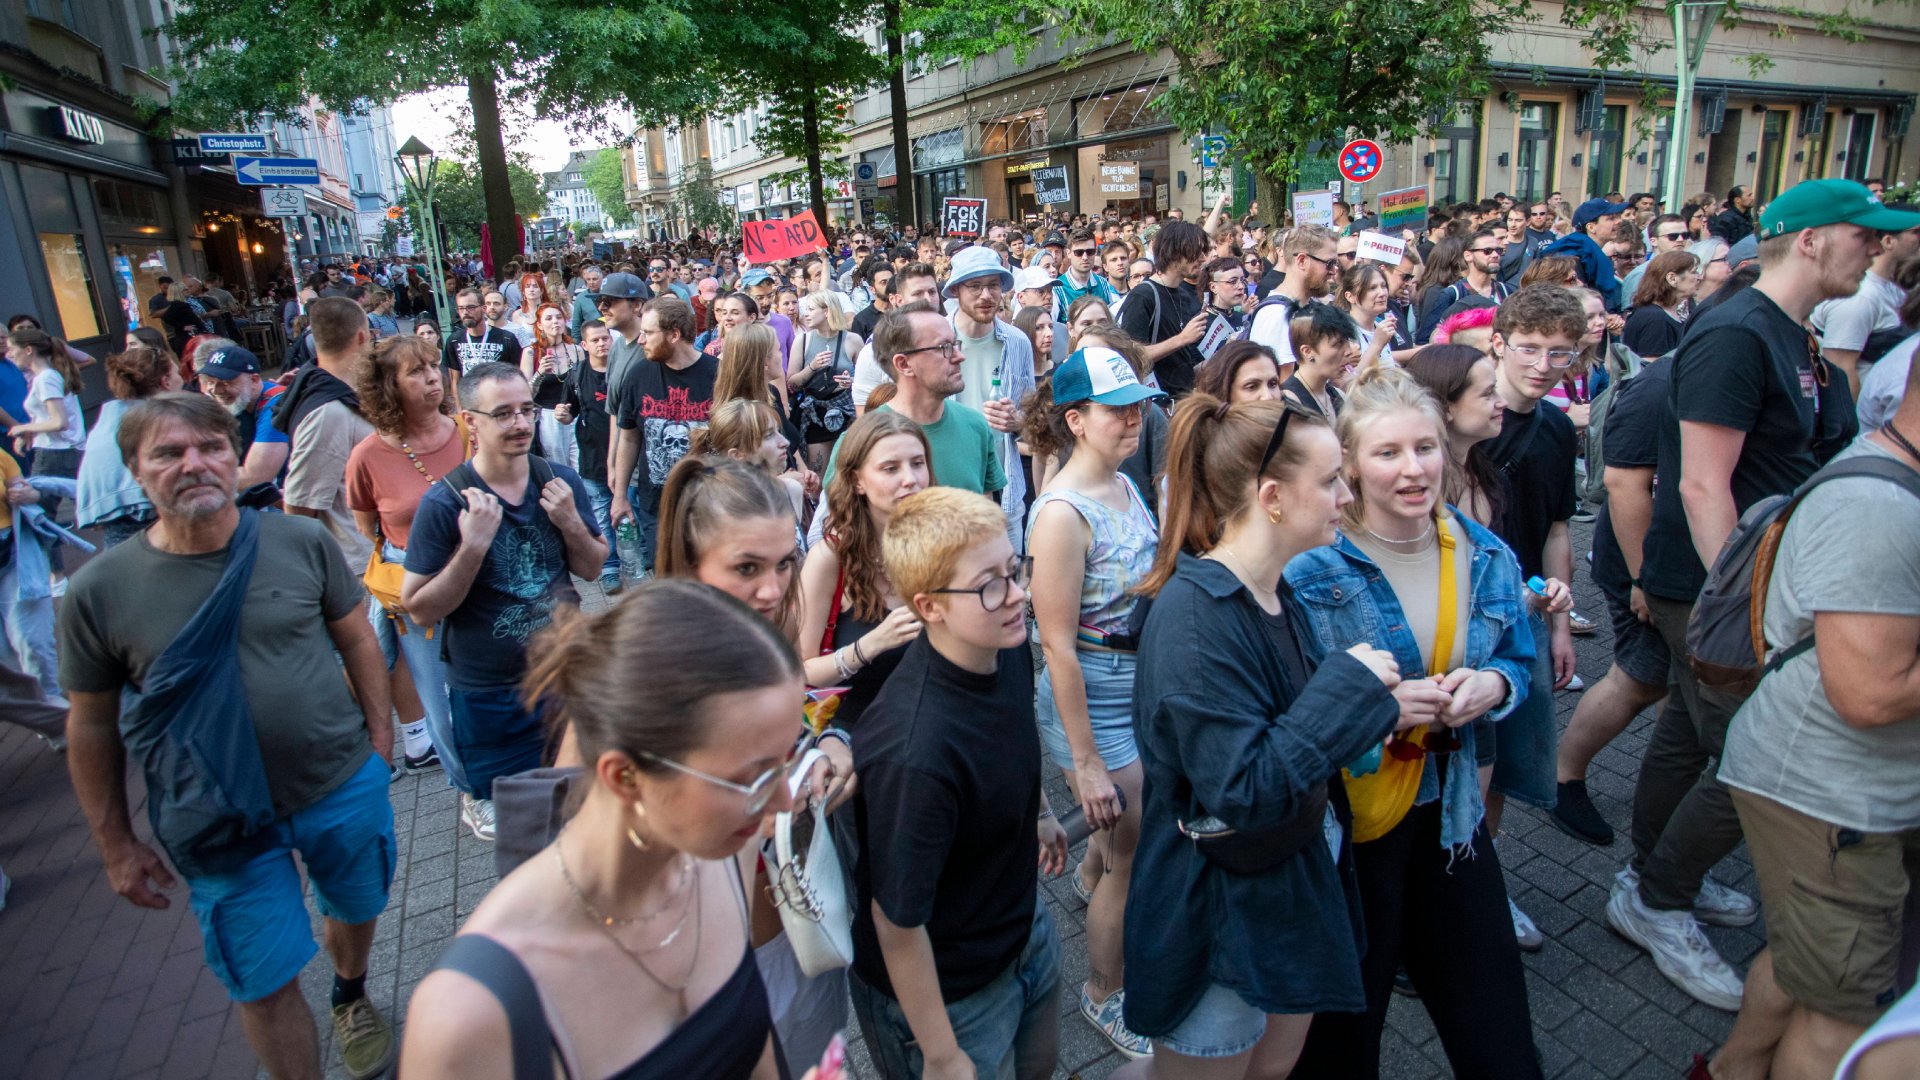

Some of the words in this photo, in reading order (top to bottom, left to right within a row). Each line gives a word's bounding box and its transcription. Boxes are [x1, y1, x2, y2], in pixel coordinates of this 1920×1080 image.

[60, 106, 104, 145] KIND
[208, 138, 265, 149] Christophstr.
[259, 167, 314, 176] Einbahnstraße
[948, 205, 979, 220] FCK
[947, 218, 979, 233] AFD
[1371, 240, 1403, 256] PARTEI
[1205, 322, 1225, 350] PARTEI
